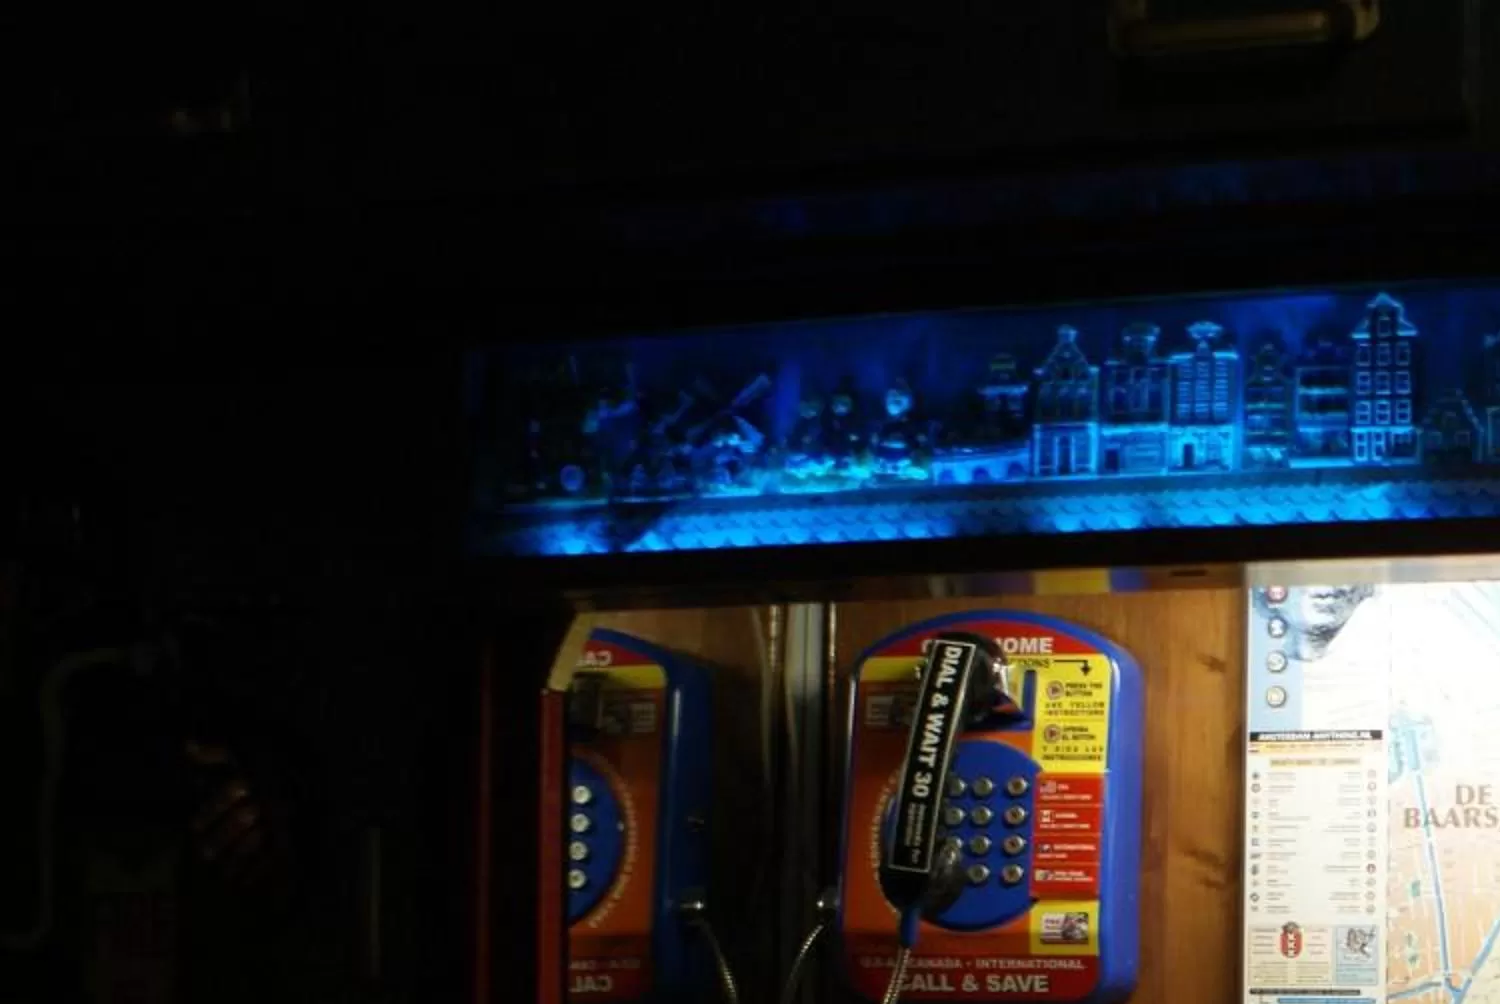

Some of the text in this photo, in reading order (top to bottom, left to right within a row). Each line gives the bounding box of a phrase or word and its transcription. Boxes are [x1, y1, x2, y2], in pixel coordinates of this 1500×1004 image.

[996, 637, 1054, 653] OME
[936, 646, 963, 688] DIAL
[931, 695, 948, 707] &
[918, 714, 944, 768] WAIT
[912, 771, 932, 797] 30
[1455, 785, 1492, 805] DE
[976, 958, 1087, 970] INTERNATIONAL
[898, 973, 1049, 992] CALL & SAVE
